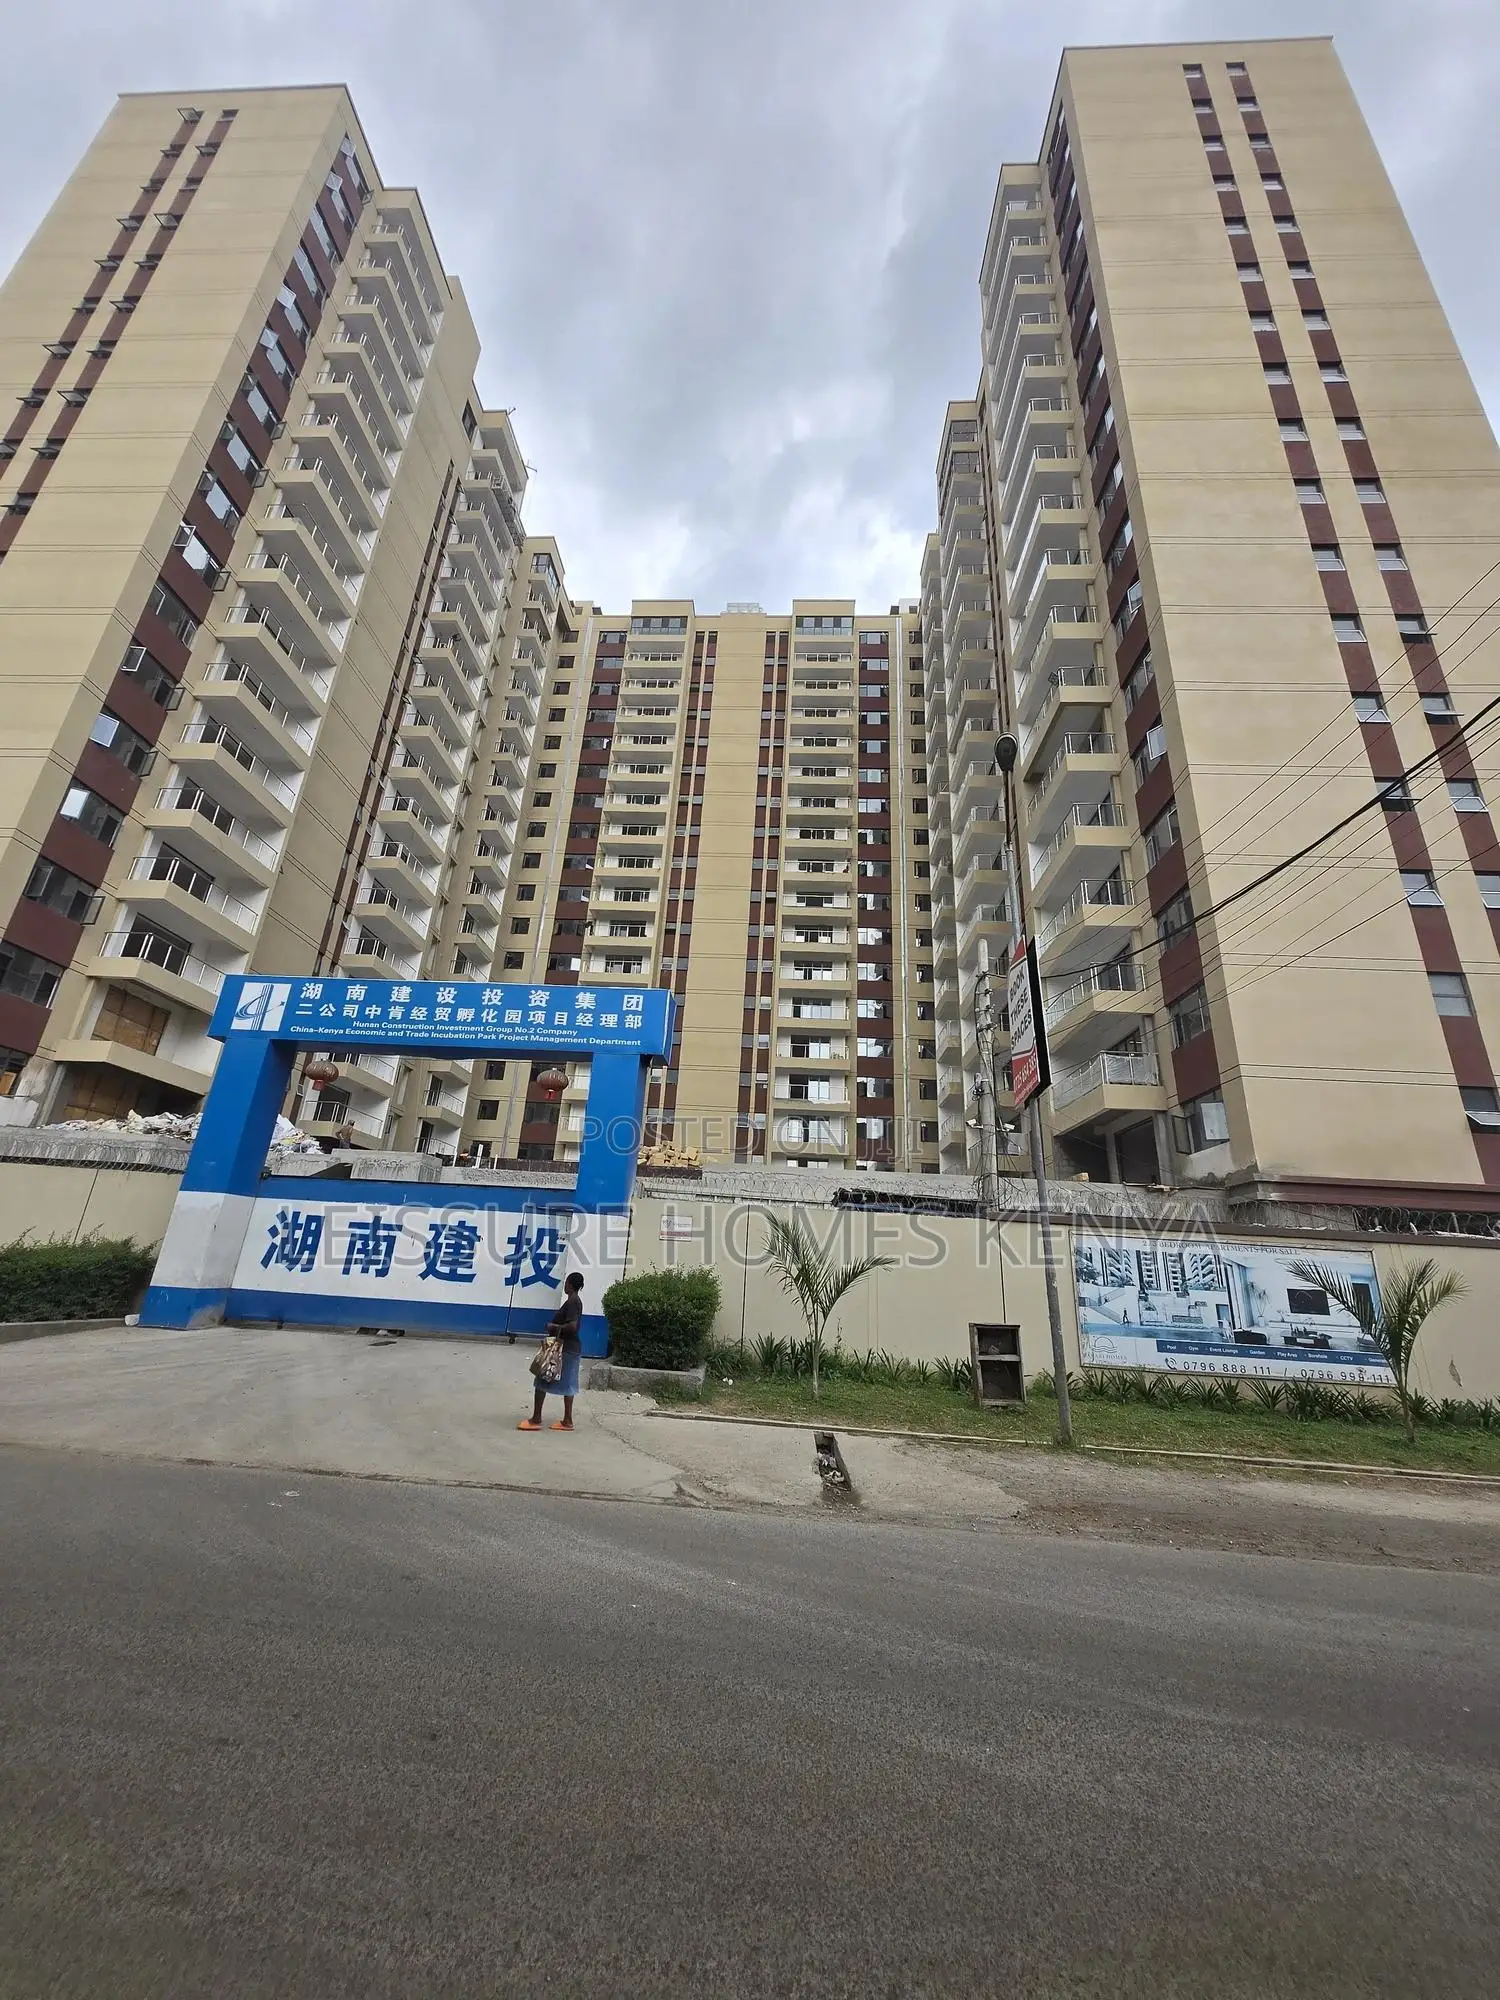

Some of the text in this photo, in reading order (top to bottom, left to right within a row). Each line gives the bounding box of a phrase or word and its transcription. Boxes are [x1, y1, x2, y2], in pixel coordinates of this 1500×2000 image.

[300, 982, 643, 1011] 湖南建设投资集团
[1011, 987, 1028, 1025] THESE
[295, 1003, 642, 1029] 二公司中肯经贸孵化园项目经理部
[381, 1022, 434, 1030] Construction
[436, 1024, 484, 1032] Investment
[486, 1026, 512, 1034] Group
[536, 1028, 577, 1036] Company
[1011, 1009, 1032, 1050] SPACES
[345, 1028, 386, 1036] Economic
[498, 1034, 529, 1042] Project
[530, 1035, 587, 1044] Management
[589, 1037, 641, 1046] Department
[260, 1210, 567, 1289] 湖南建投
[1184, 1361, 1216, 1372] 0796
[1223, 1363, 1247, 1374] 888
[1253, 1366, 1271, 1375] 111
[1301, 1369, 1334, 1380] 0796
[1371, 1374, 1390, 1384] 111
